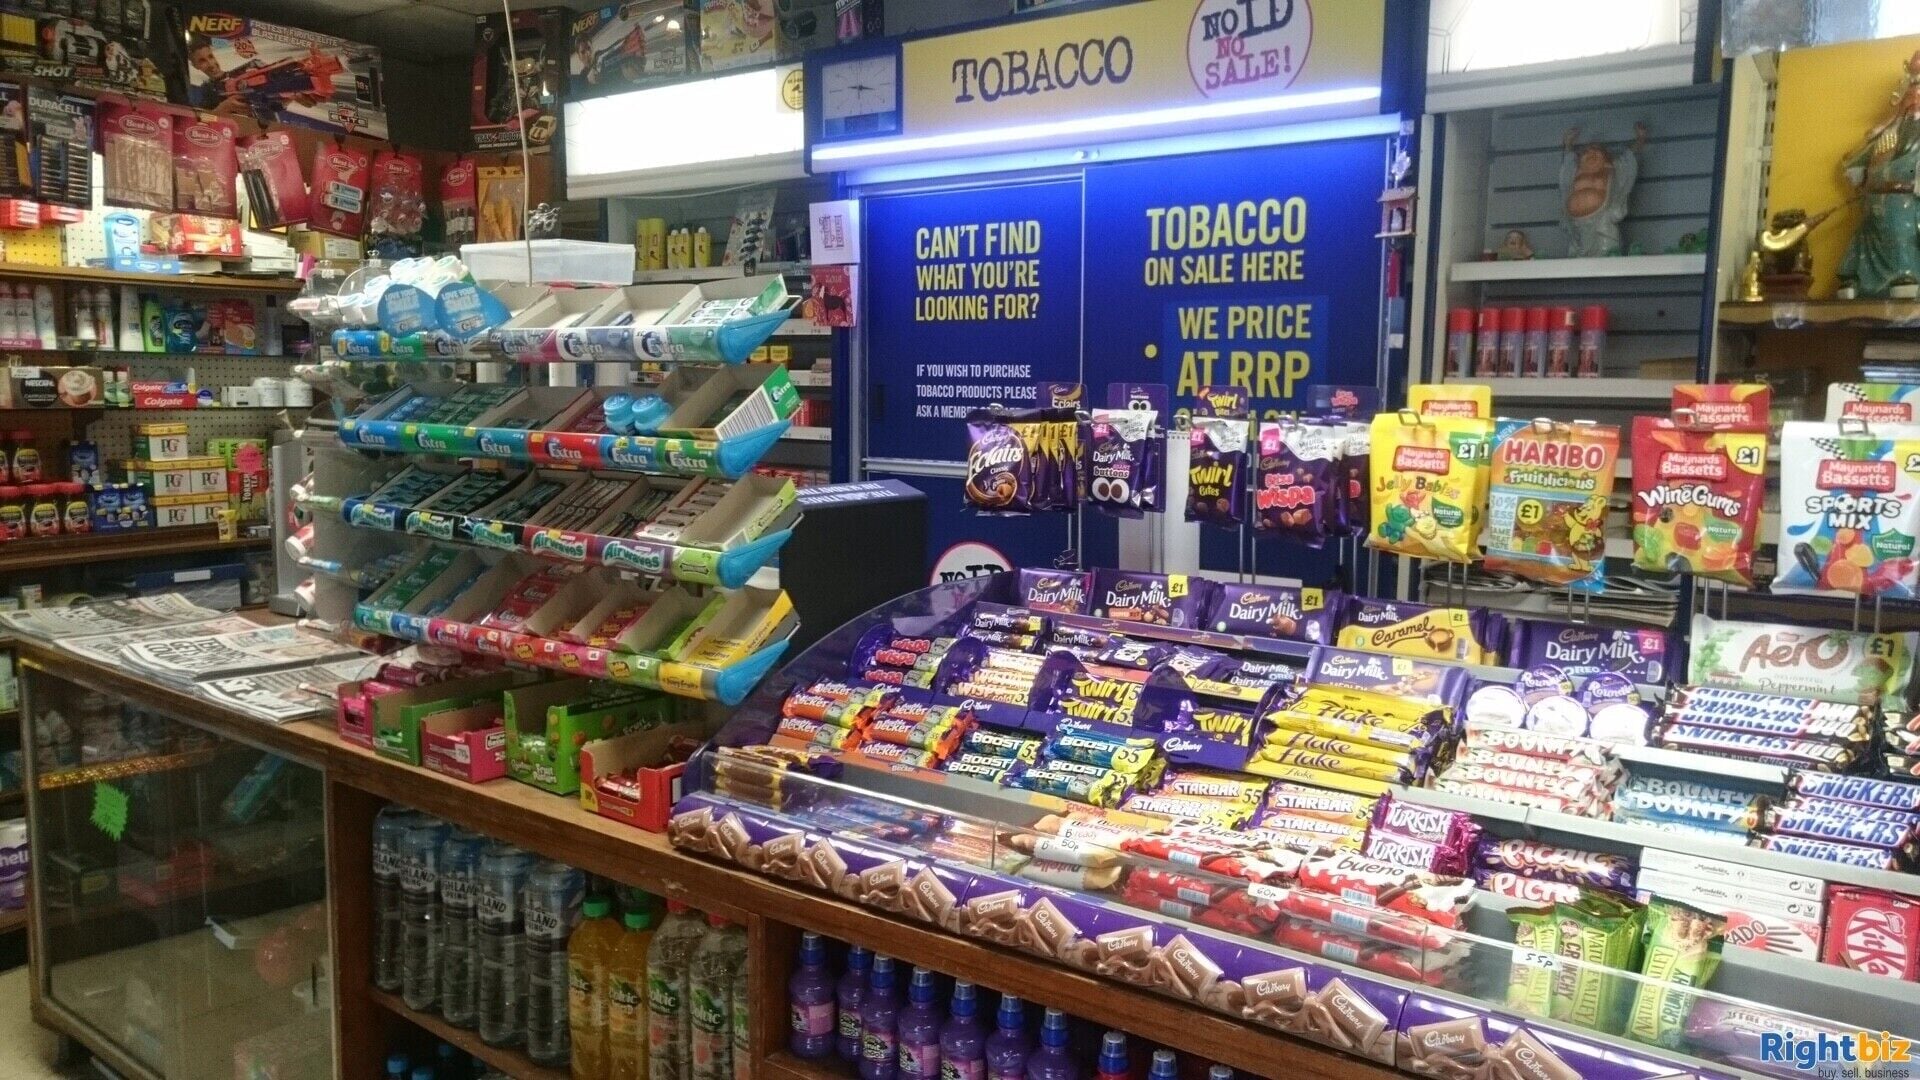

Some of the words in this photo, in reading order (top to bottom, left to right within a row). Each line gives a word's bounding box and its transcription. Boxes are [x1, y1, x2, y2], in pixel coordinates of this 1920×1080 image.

[190, 15, 243, 33] NERF
[571, 12, 599, 36] NERF
[1202, 7, 1239, 41] NO
[1238, 0, 1293, 38] ID
[1215, 34, 1245, 60] NO
[33, 64, 73, 78] SHOT
[952, 35, 1134, 104] TOBACCO
[1205, 45, 1292, 90] SALE!
[28, 96, 83, 116] DURACELL
[1146, 196, 1307, 251] TOBACCO
[915, 223, 979, 260] CAN'T
[985, 220, 1041, 257] FIND
[916, 263, 966, 291] WHAT
[970, 260, 1040, 290] YOU'RE
[1144, 256, 1174, 287] ON
[1180, 253, 1235, 285] SALE
[1241, 249, 1305, 282] HERE
[915, 295, 988, 322] LOOKING
[994, 293, 1040, 320] FOR?
[1177, 306, 1220, 340] WE
[1227, 303, 1312, 340] PRICE
[916, 364, 925, 378] IF
[926, 364, 944, 378] YOU
[945, 364, 969, 378] WISH
[970, 364, 981, 378] TO
[983, 364, 1031, 378] PURCHASE
[1176, 351, 1219, 397] AT
[1230, 350, 1311, 398] RRP
[132, 382, 164, 393] Colgate
[916, 384, 954, 398] TOBACCO
[956, 384, 1002, 399] PRODUCTS
[1003, 385, 1037, 400] PLEASE
[143, 396, 184, 407] Colgate
[1207, 391, 1239, 410] Twirl
[1695, 403, 1747, 415] Maynards
[1851, 403, 1905, 415] Maynards
[916, 405, 933, 418] ASK
[933, 405, 940, 418] A
[360, 431, 386, 445] Extra
[1059, 424, 1073, 438] £1
[1495, 424, 1517, 442] NEW
[160, 438, 180, 453] PG
[418, 432, 447, 450] Extra
[480, 437, 512, 455] Extra
[548, 441, 583, 460] Extra
[611, 447, 648, 466] Extra
[968, 444, 1024, 475] Eclairs
[1092, 450, 1115, 463] Dairy
[1115, 450, 1133, 462] Milk
[1402, 448, 1445, 461] Maynards
[1456, 442, 1476, 460] £1
[1503, 438, 1605, 472] HARIBO
[1666, 452, 1721, 466] Maynards
[1736, 447, 1760, 465] £1
[669, 450, 708, 470] Extra
[1395, 455, 1447, 471] Bassetts
[1828, 461, 1888, 475] Maynards
[201, 471, 220, 486] PG
[1093, 465, 1130, 479] buttons
[1190, 461, 1234, 488] Twirl
[1661, 462, 1724, 477] Bassetts
[165, 473, 184, 488] PG
[1376, 475, 1412, 496] Jelly
[1415, 477, 1460, 499] Babies
[1821, 471, 1890, 487] Bassetts
[1199, 485, 1220, 497] Bites
[168, 508, 187, 523] PG
[1433, 508, 1462, 517] Natural
[1521, 504, 1541, 520] £1
[1805, 494, 1902, 519] SPORTS
[1708, 526, 1740, 535] Natural
[1827, 513, 1872, 531] MIX
[532, 532, 586, 558] Airwaves
[1875, 541, 1911, 551] Natural
[603, 540, 661, 569] Airwaves
[1028, 587, 1063, 604] Dairy
[1061, 587, 1085, 604] Milk
[1170, 582, 1184, 594] £1
[1106, 591, 1141, 609] Dairy
[1140, 590, 1169, 607] Milk
[1304, 594, 1319, 606] £1
[1228, 604, 1267, 622] Dairy
[1268, 602, 1300, 621] Milk
[1358, 611, 1379, 623] Dairy
[1380, 611, 1401, 622] Milk
[1371, 616, 1435, 647] Caramel
[1558, 629, 1599, 644] Cadbury
[1545, 641, 1596, 665] Dairy
[1598, 642, 1645, 663] Milk
[1642, 638, 1660, 650] £1
[1739, 633, 1850, 673] Aero
[1869, 637, 1895, 658] £1
[1242, 661, 1267, 675] Dairy
[1320, 662, 1355, 679] Dairy
[1356, 663, 1386, 681] Milk
[1072, 678, 1128, 700] Twirl
[1758, 677, 1837, 696] Peppermint
[1059, 699, 1119, 723] Twirl
[1318, 700, 1384, 729] Flake
[781, 718, 819, 734] Decker
[875, 720, 912, 733] Decker
[972, 732, 1025, 750] BOOST
[1060, 736, 1117, 753] BOOST
[1163, 737, 1203, 753] Cadbury
[1288, 731, 1351, 756] Flake
[1672, 724, 1790, 751] SNICKERS
[864, 745, 903, 759] Decker
[961, 753, 1010, 769] BOOST
[1117, 748, 1141, 764] 55
[1278, 747, 1342, 770] Flake
[949, 762, 998, 777] BOOST
[1026, 768, 1076, 784] BOOST
[1049, 760, 1108, 777] BOOST
[1173, 781, 1240, 797] STARBAR
[1241, 788, 1263, 804] 55
[1801, 774, 1920, 810] SNICKERS
[1276, 793, 1354, 813] STARBAR
[1271, 816, 1350, 835] STARBAR
[1388, 801, 1450, 834] TURKISH
[1781, 811, 1901, 848] SNICKERS
[1366, 835, 1434, 868] TURKISH
[1336, 853, 1405, 877] bueno
[1107, 936, 1139, 951] Cadbury
[1848, 915, 1906, 977] KitKa
[1172, 947, 1200, 980] Cadbury
[1524, 952, 1554, 968] 55p
[1256, 980, 1291, 996] Cadbury
[1331, 995, 1364, 1030] Cadbury
[1424, 1030, 1466, 1048] Cadbury
